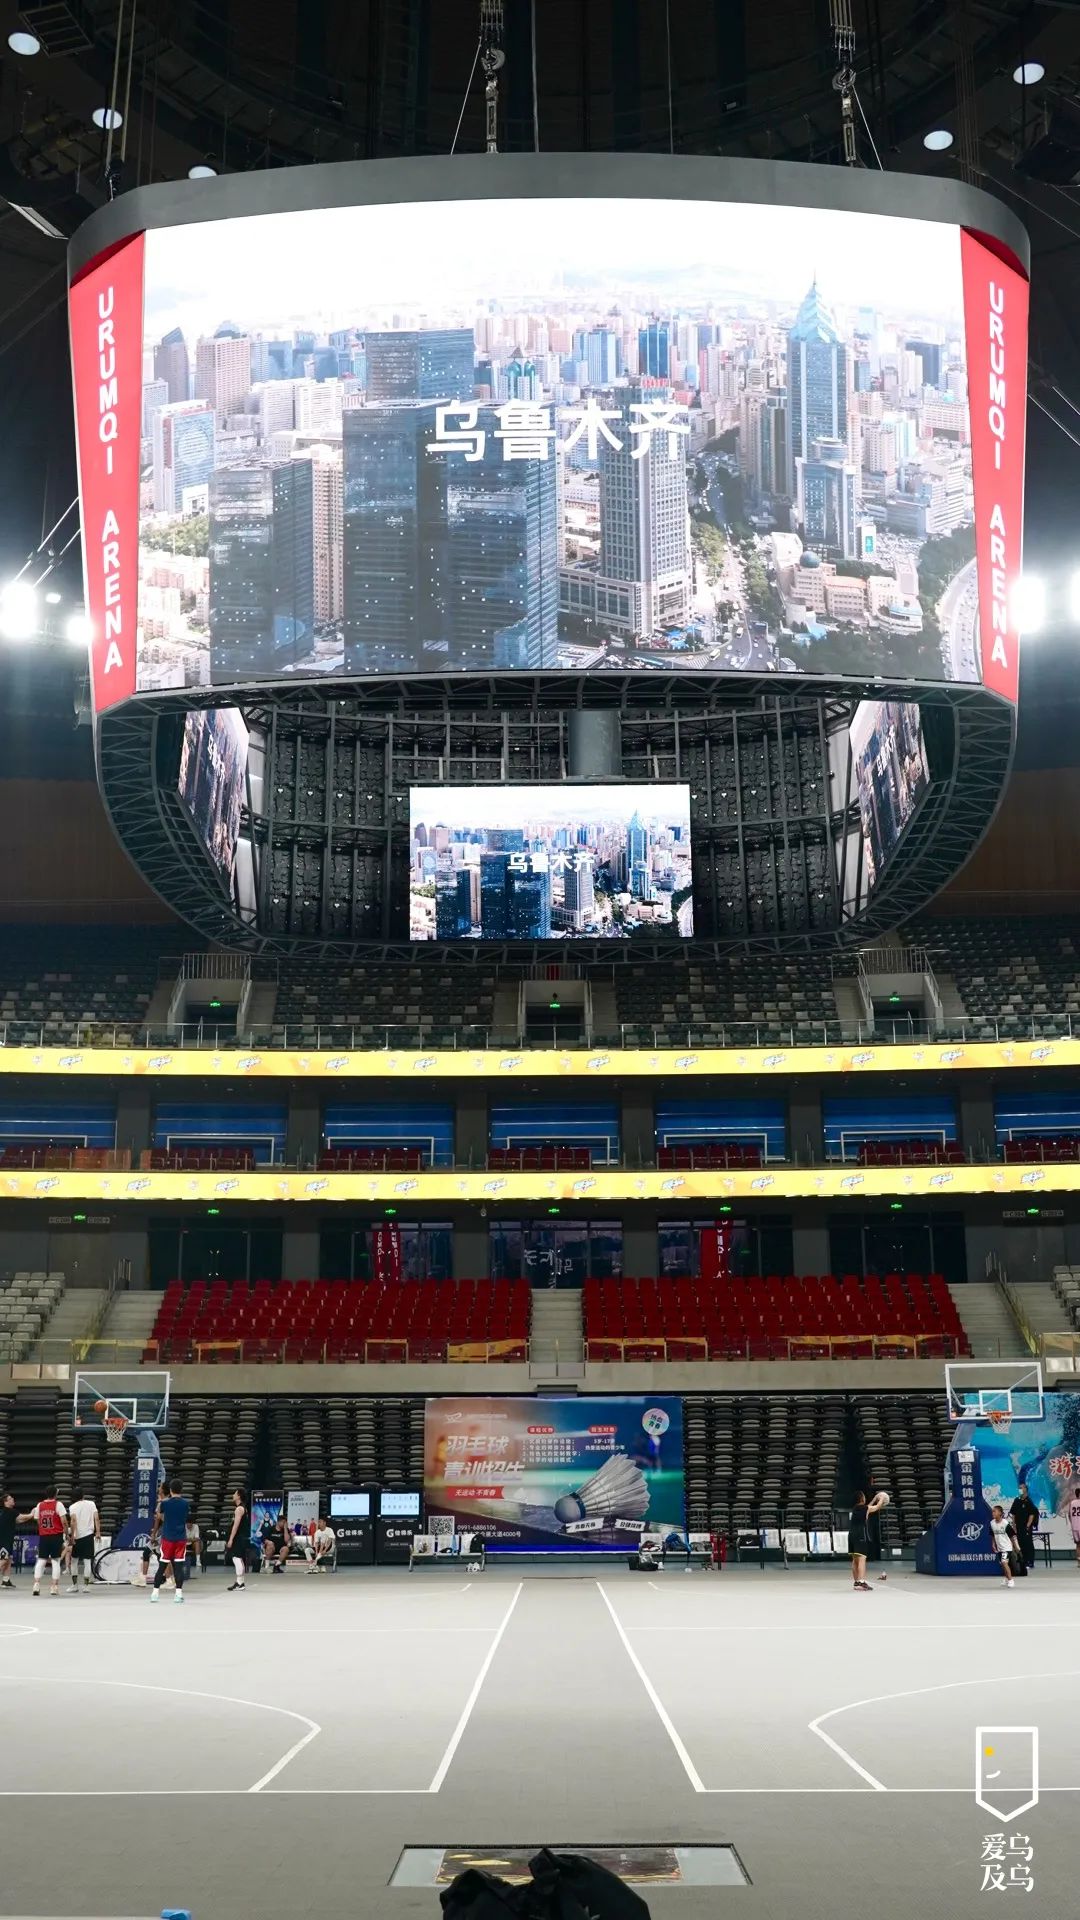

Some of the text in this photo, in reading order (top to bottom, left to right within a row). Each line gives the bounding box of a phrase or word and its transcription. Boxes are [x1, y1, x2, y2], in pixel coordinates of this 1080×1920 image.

[426, 398, 691, 461] 乌鲁木齐
[97, 286, 123, 674] URUMQI ARENA
[987, 282, 1008, 669] URUMQI ARENA
[507, 851, 595, 873] 乌鲁木齐
[446, 1435, 510, 1456] 羽毛球
[443, 1461, 525, 1481] 青训招生
[1049, 1453, 1080, 1480] 游
[138, 1470, 150, 1519] 金陵体育
[961, 1462, 975, 1511] 金陵体育
[41, 1517, 54, 1529] 91
